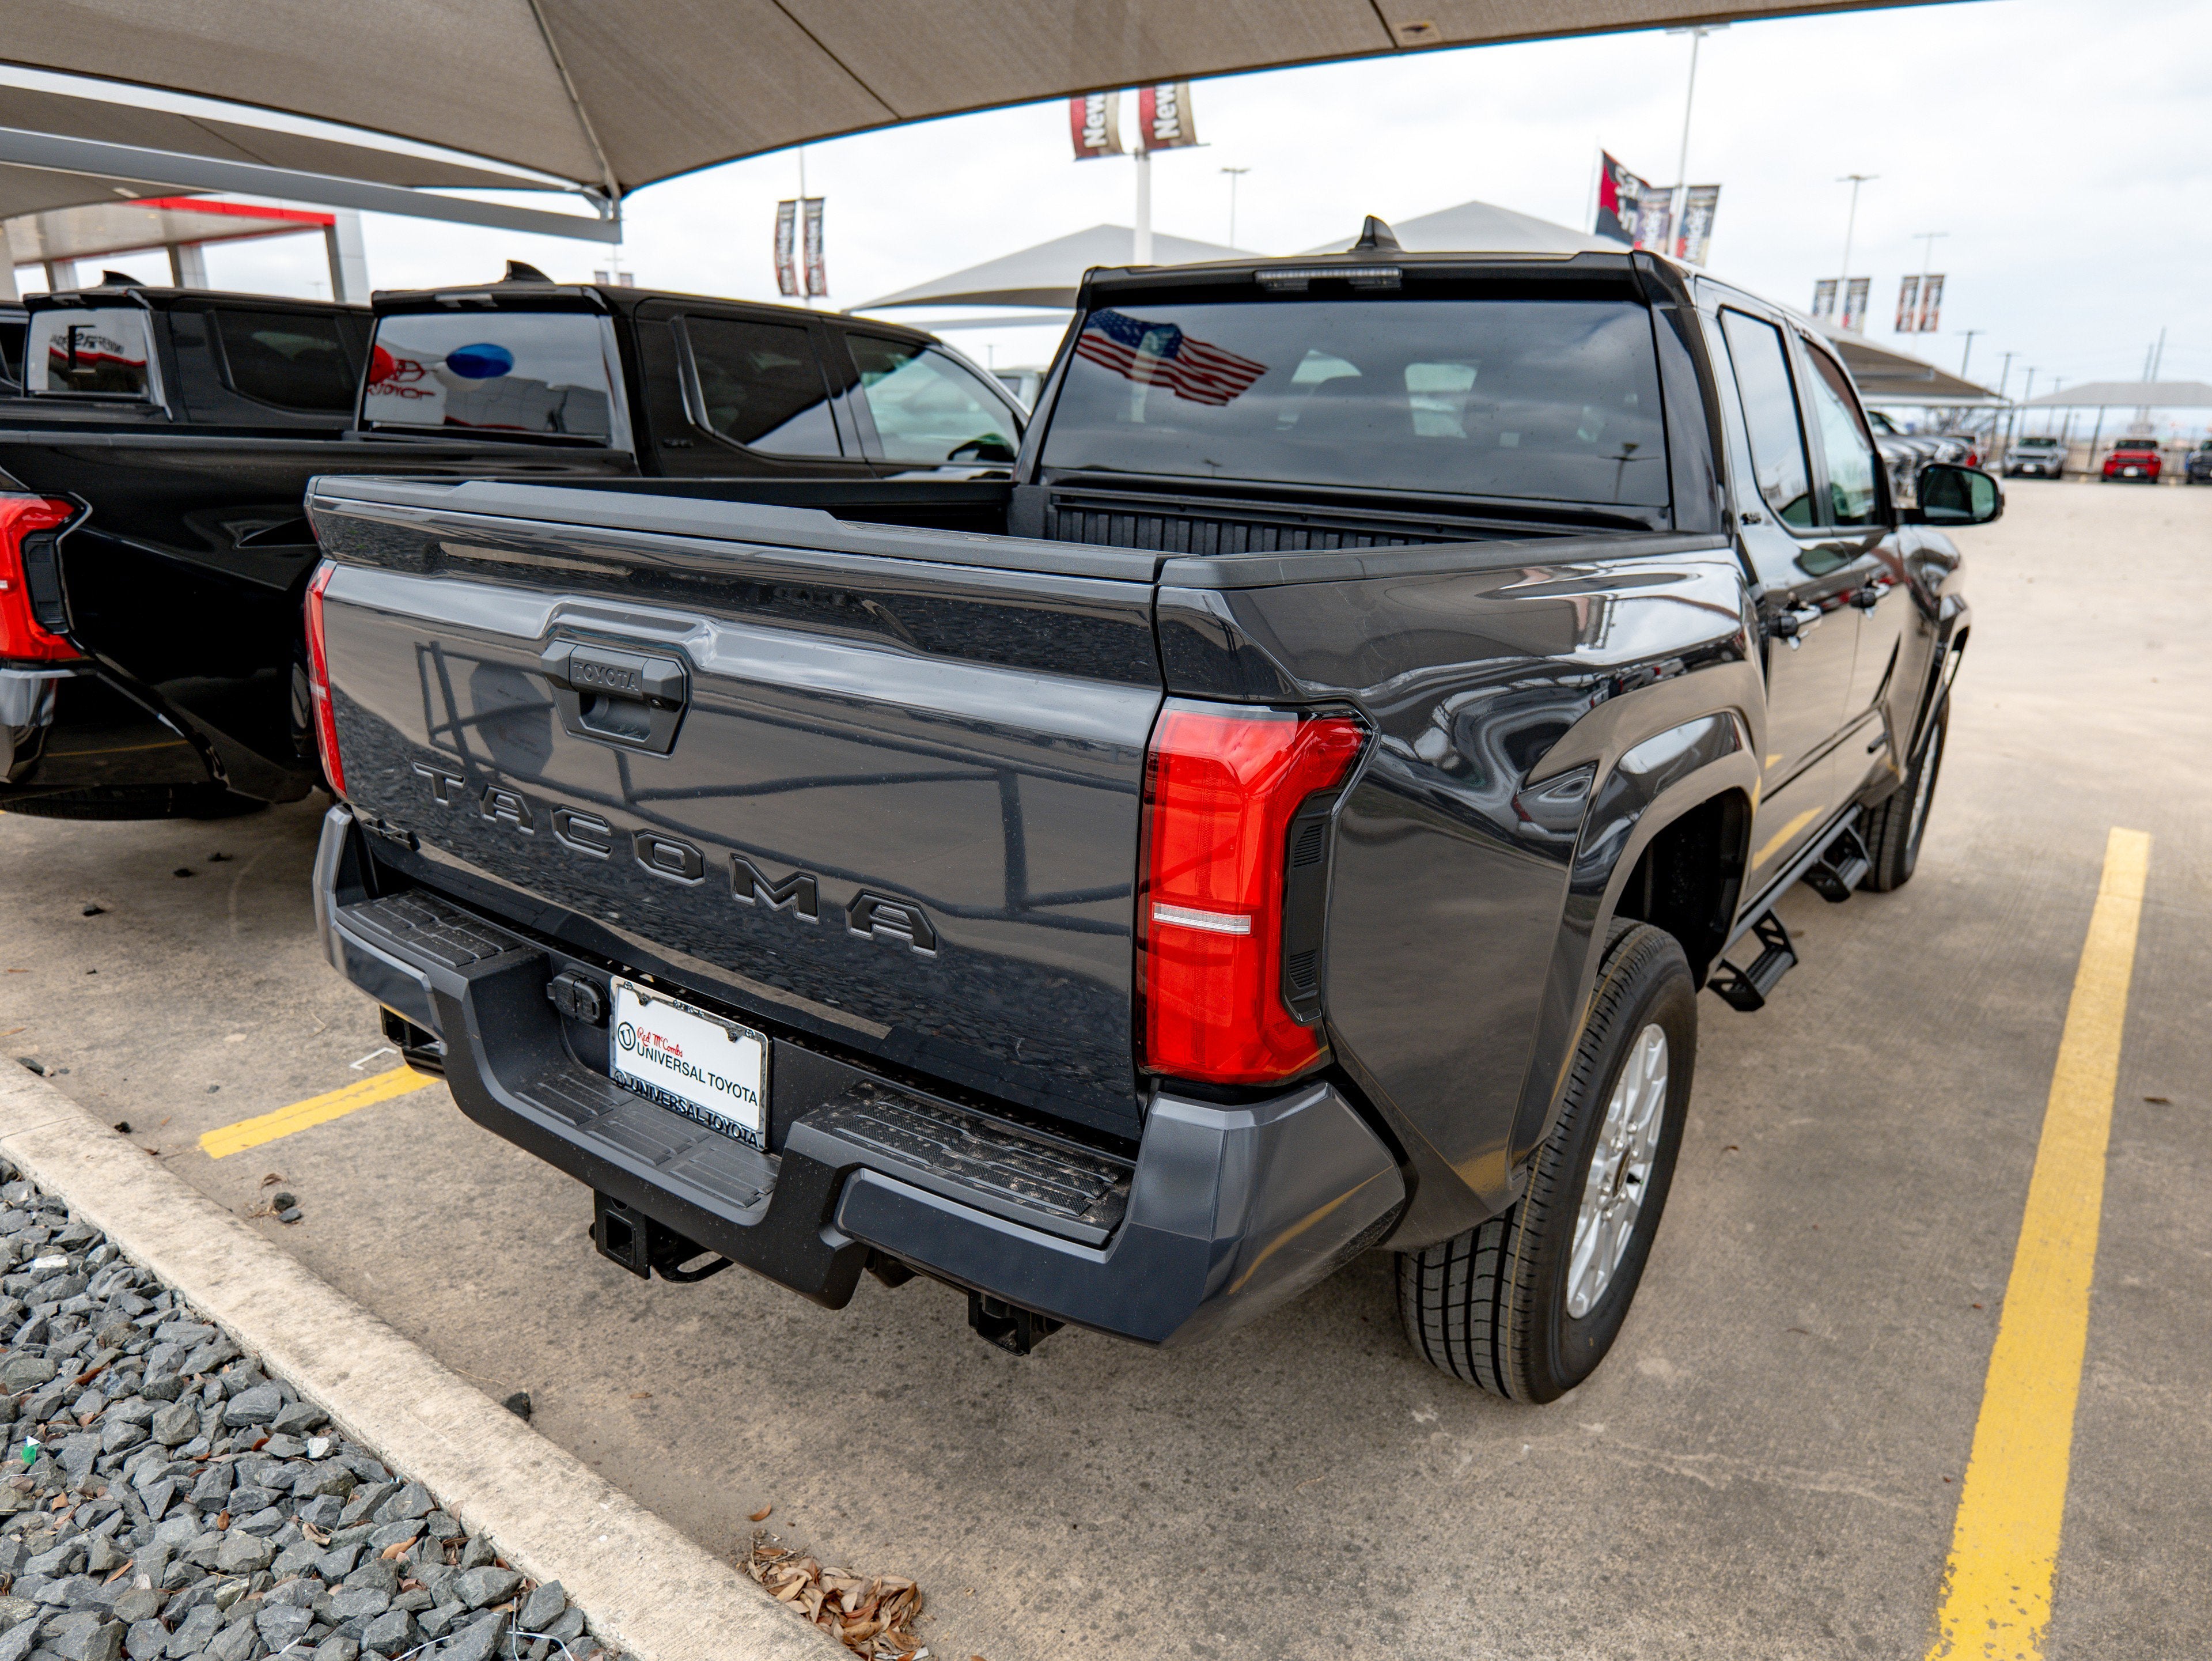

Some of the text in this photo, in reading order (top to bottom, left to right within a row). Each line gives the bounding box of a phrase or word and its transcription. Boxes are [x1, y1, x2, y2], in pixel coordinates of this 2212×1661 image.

[1153, 85, 1180, 140] New
[573, 661, 639, 691] TOYOTA
[412, 760, 938, 958] TACOMA
[637, 1027, 651, 1047] Red
[637, 1042, 758, 1107] UNIVERSAL TOYOTA
[630, 1076, 760, 1148] UNIVERSAL TOYOTA
